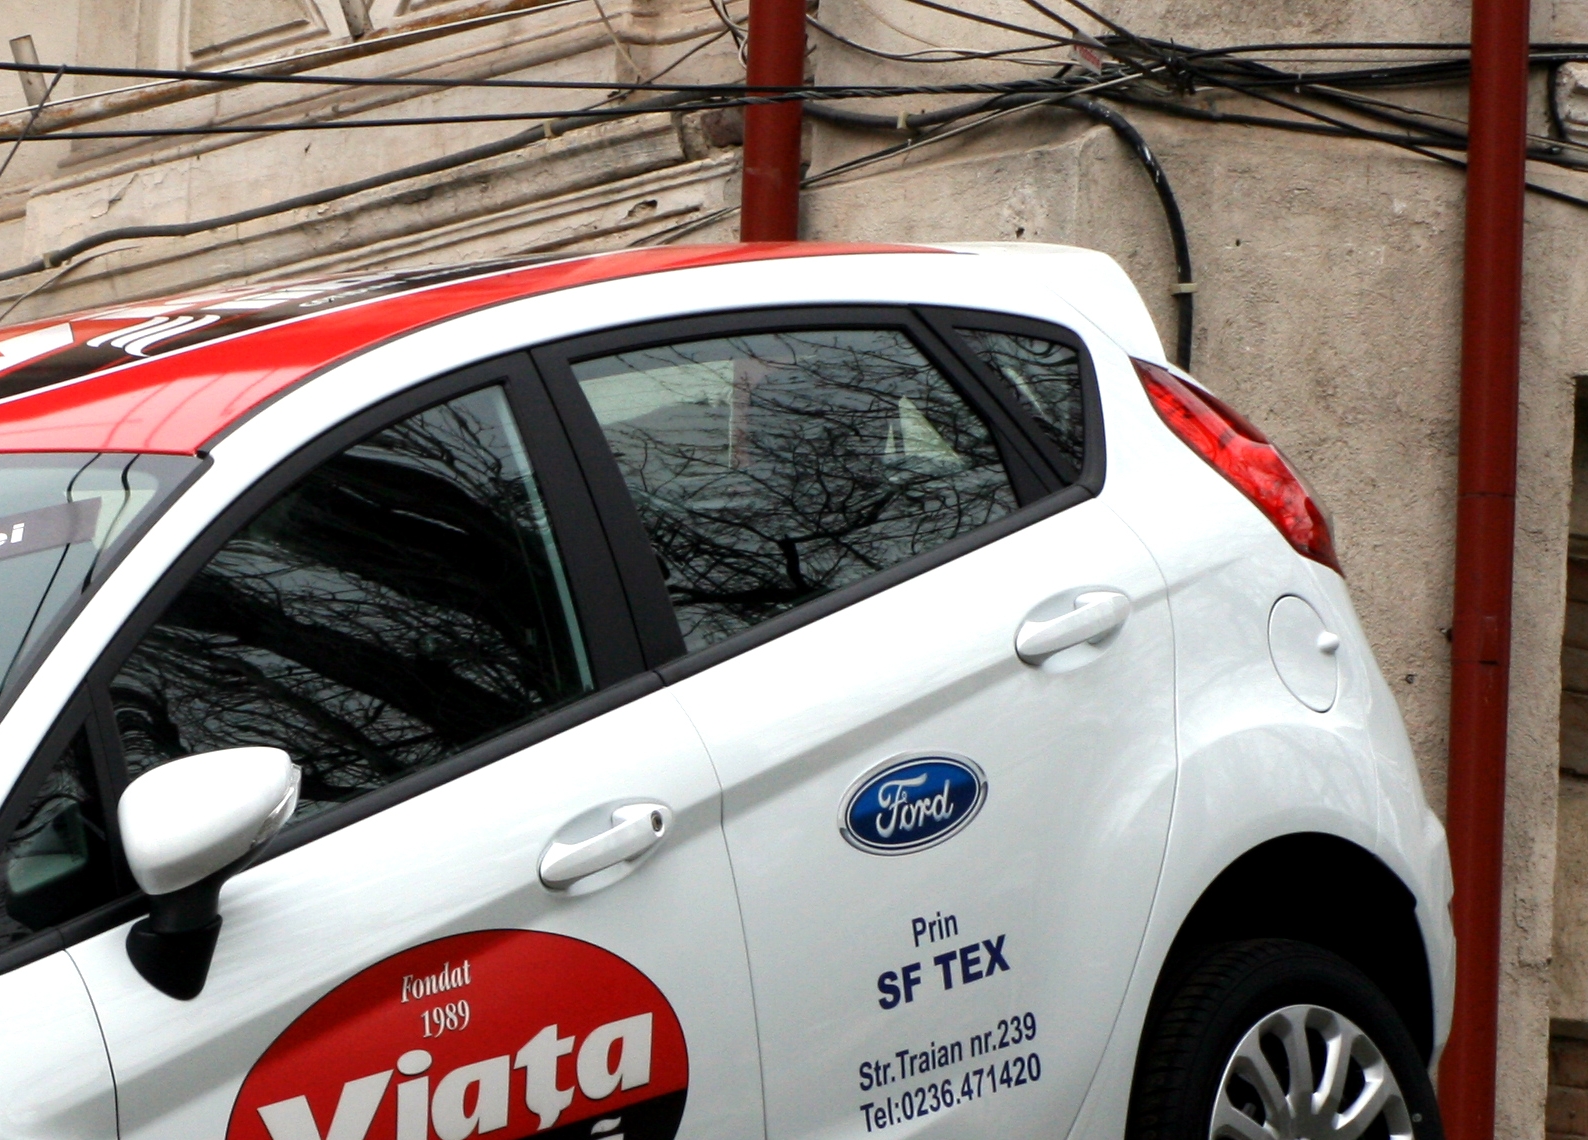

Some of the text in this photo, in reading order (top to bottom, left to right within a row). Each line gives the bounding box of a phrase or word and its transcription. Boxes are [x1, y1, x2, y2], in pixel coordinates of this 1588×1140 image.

[874, 772, 955, 839] Ford
[912, 911, 959, 948] Prin
[401, 958, 472, 1004] Fondat
[877, 934, 1010, 1010] SF TEX
[420, 999, 471, 1039] 1989
[858, 1011, 1038, 1092] Str.Traian nr.239
[860, 1052, 1042, 1133] Tel:0236.471420
